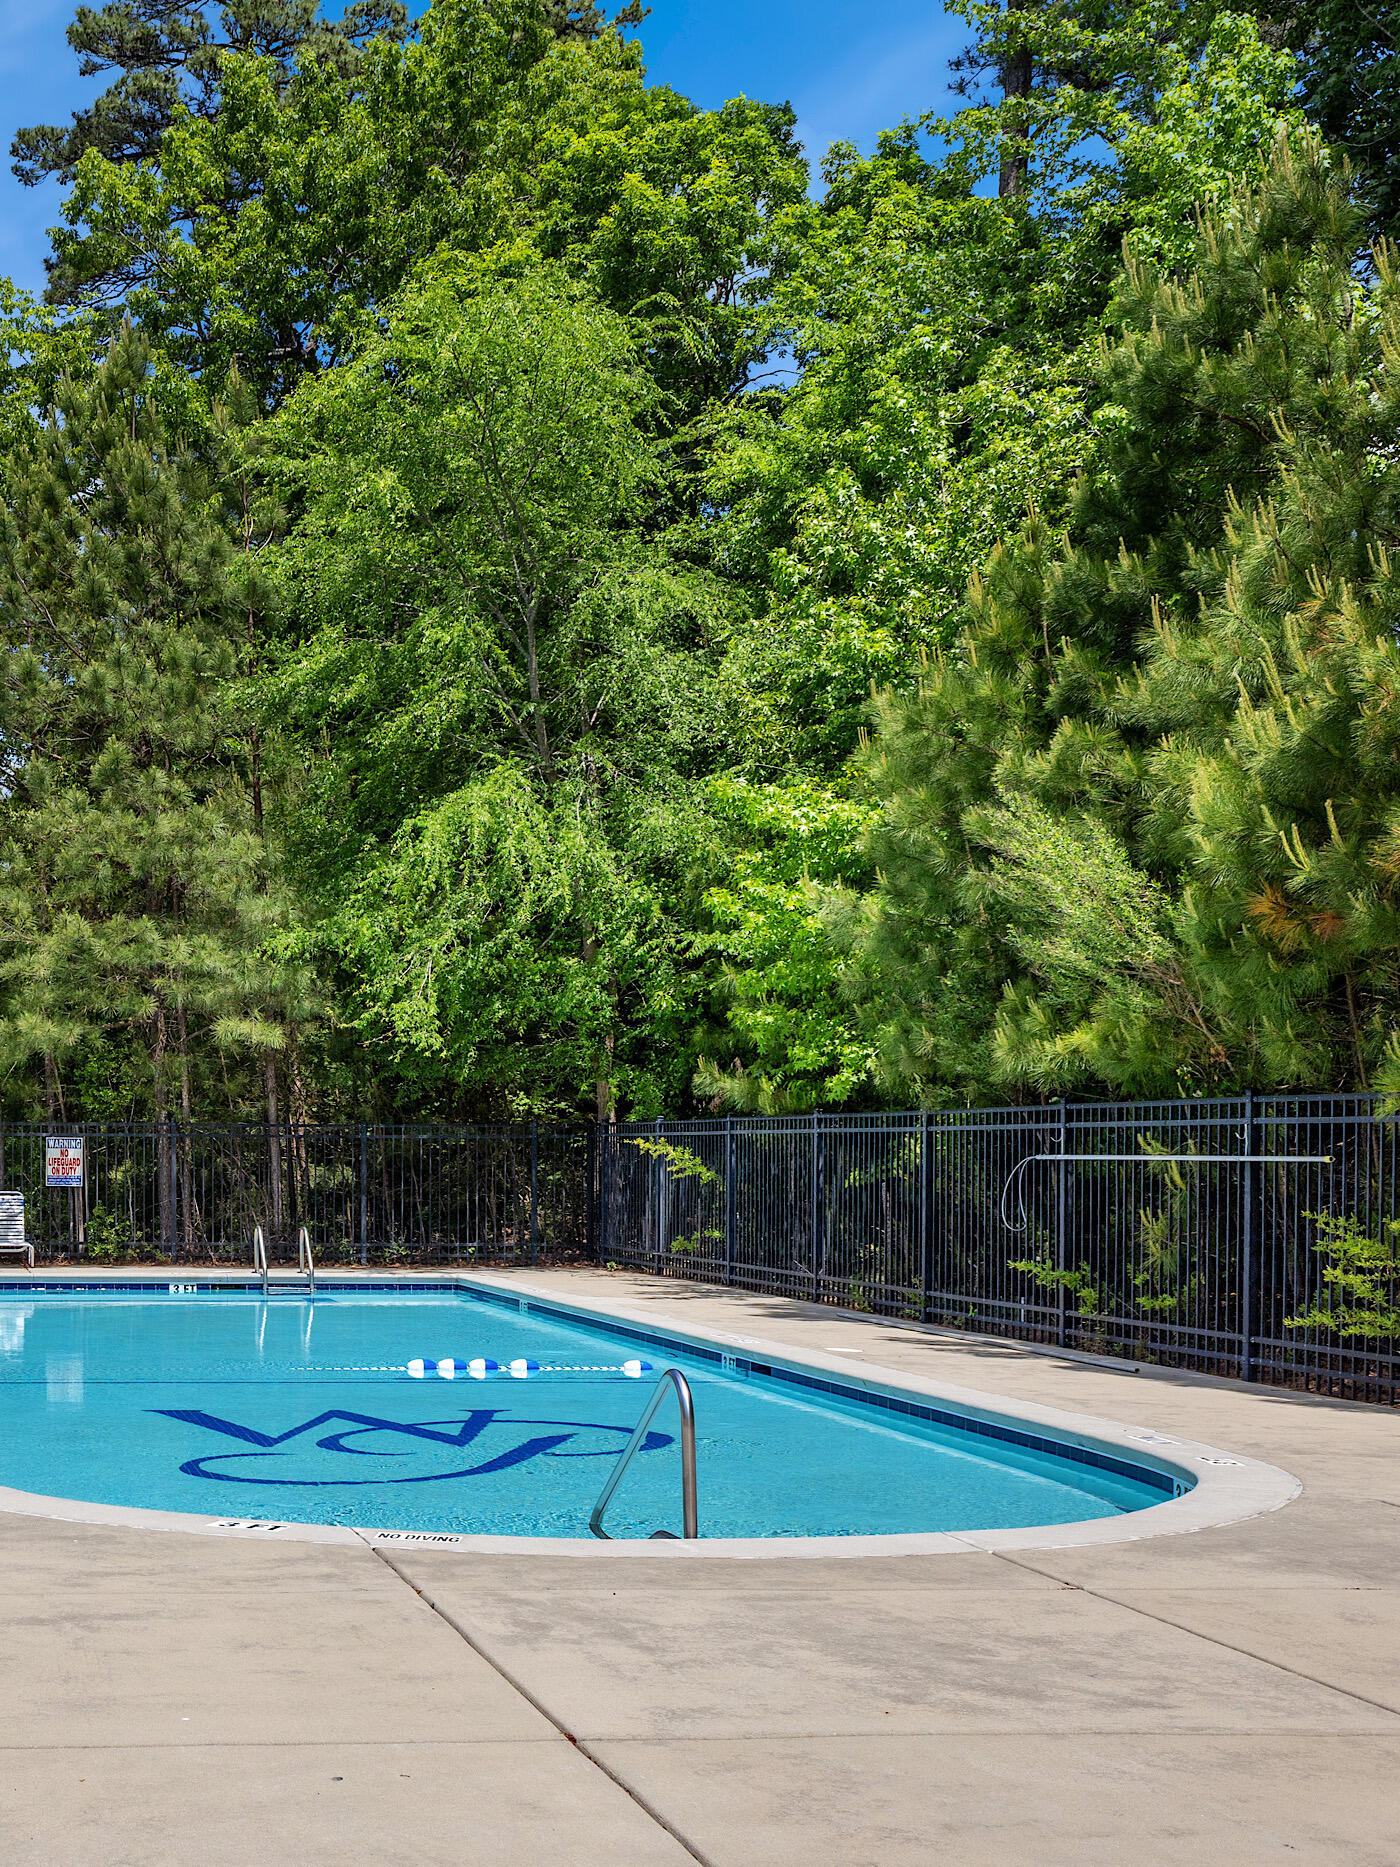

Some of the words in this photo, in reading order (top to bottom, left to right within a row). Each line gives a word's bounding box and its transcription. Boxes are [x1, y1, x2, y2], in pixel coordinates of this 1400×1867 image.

[48, 1139, 81, 1149] WARNING
[60, 1149, 69, 1157] NO
[48, 1158, 81, 1166] LIFEGUARD
[51, 1167, 60, 1175] ON
[61, 1167, 77, 1175] DUTY
[404, 1534, 460, 1543] DIVING
